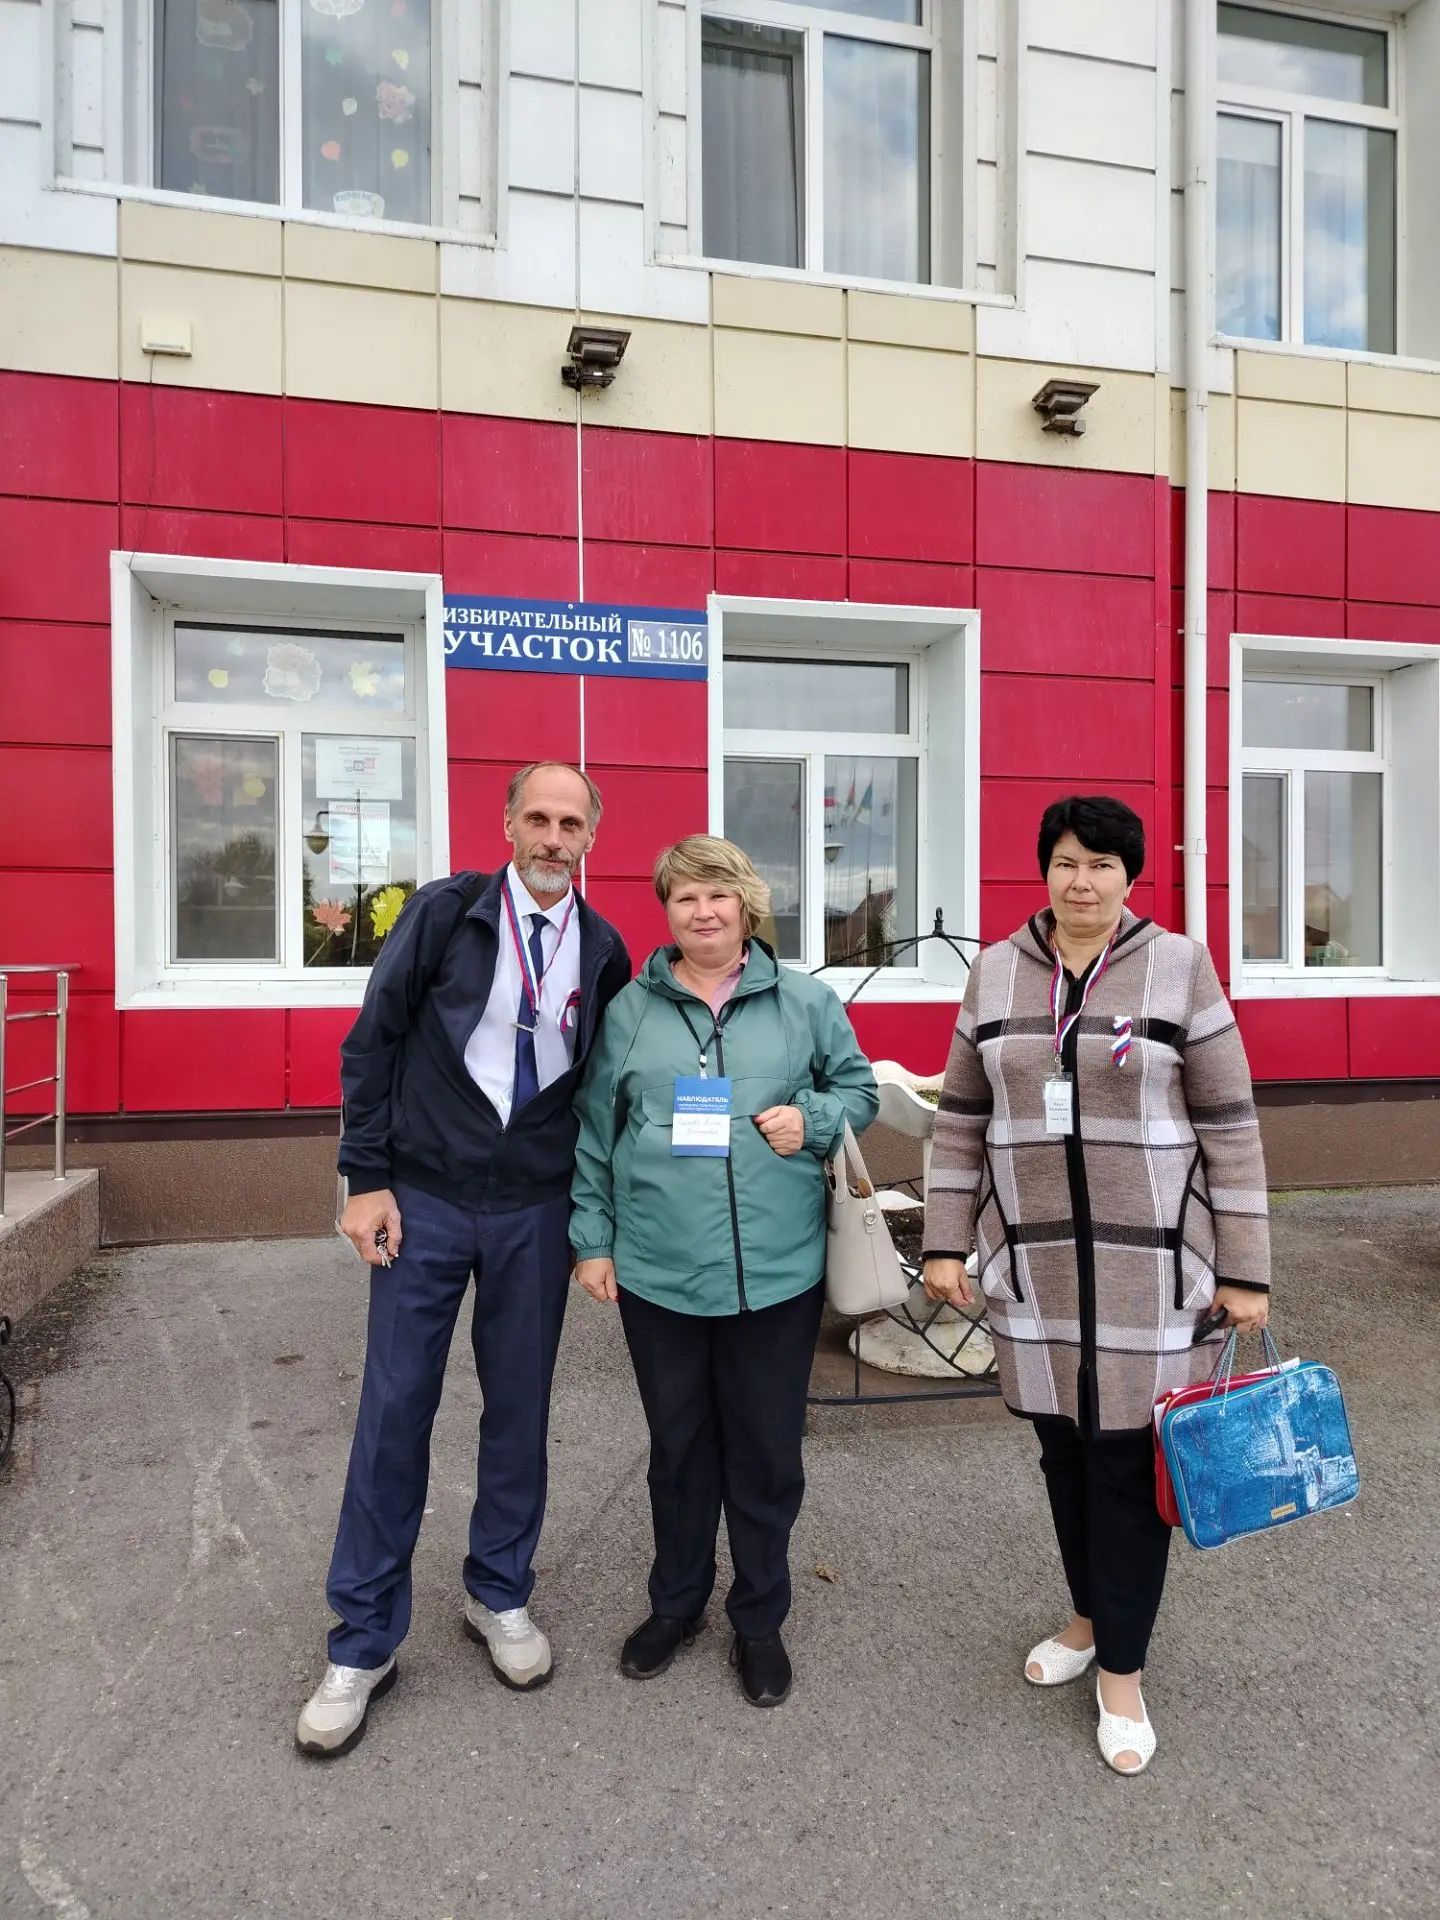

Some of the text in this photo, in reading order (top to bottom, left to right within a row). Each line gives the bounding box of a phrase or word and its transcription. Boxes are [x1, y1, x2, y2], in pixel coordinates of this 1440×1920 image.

[443, 607, 622, 633] ИЗБИРАТЕЛЬНЫЙ
[444, 630, 622, 663] УЧАСТОК
[631, 628, 703, 660] № 1106
